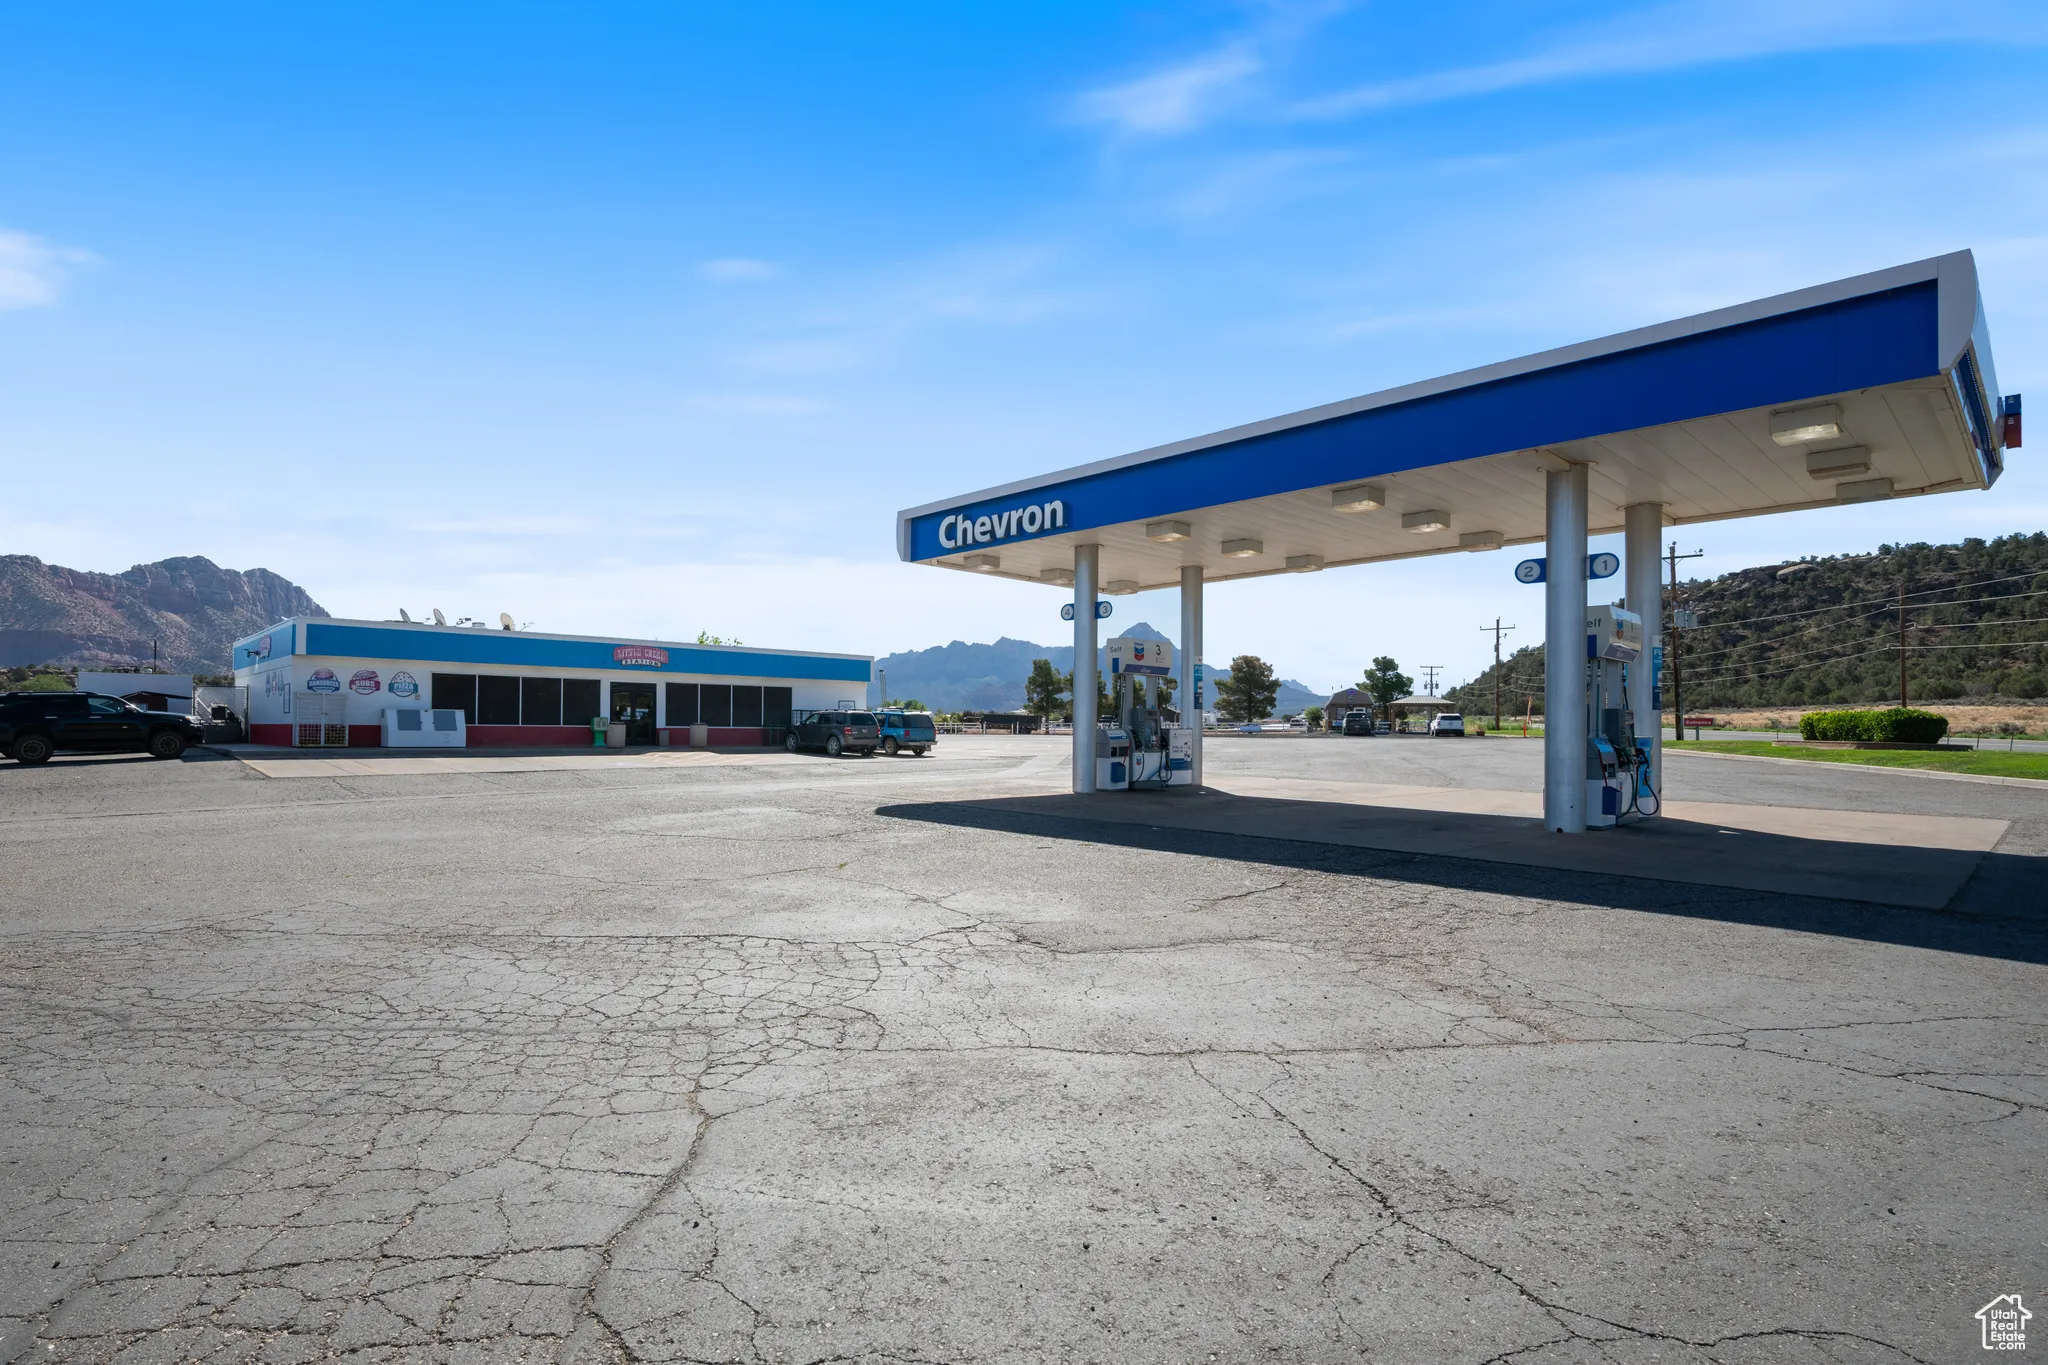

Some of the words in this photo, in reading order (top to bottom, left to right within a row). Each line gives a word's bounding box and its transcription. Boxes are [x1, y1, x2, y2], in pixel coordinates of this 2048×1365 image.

[938, 499, 1064, 549] Chevron
[1602, 559, 1609, 571] 1
[1523, 566, 1534, 578] 2
[1064, 608, 1071, 616] 4
[1102, 605, 1108, 614] 3
[1587, 617, 1603, 628] elf
[1110, 646, 1123, 654] Self
[1155, 644, 1162, 656] 3
[394, 682, 414, 690] PIZZA
